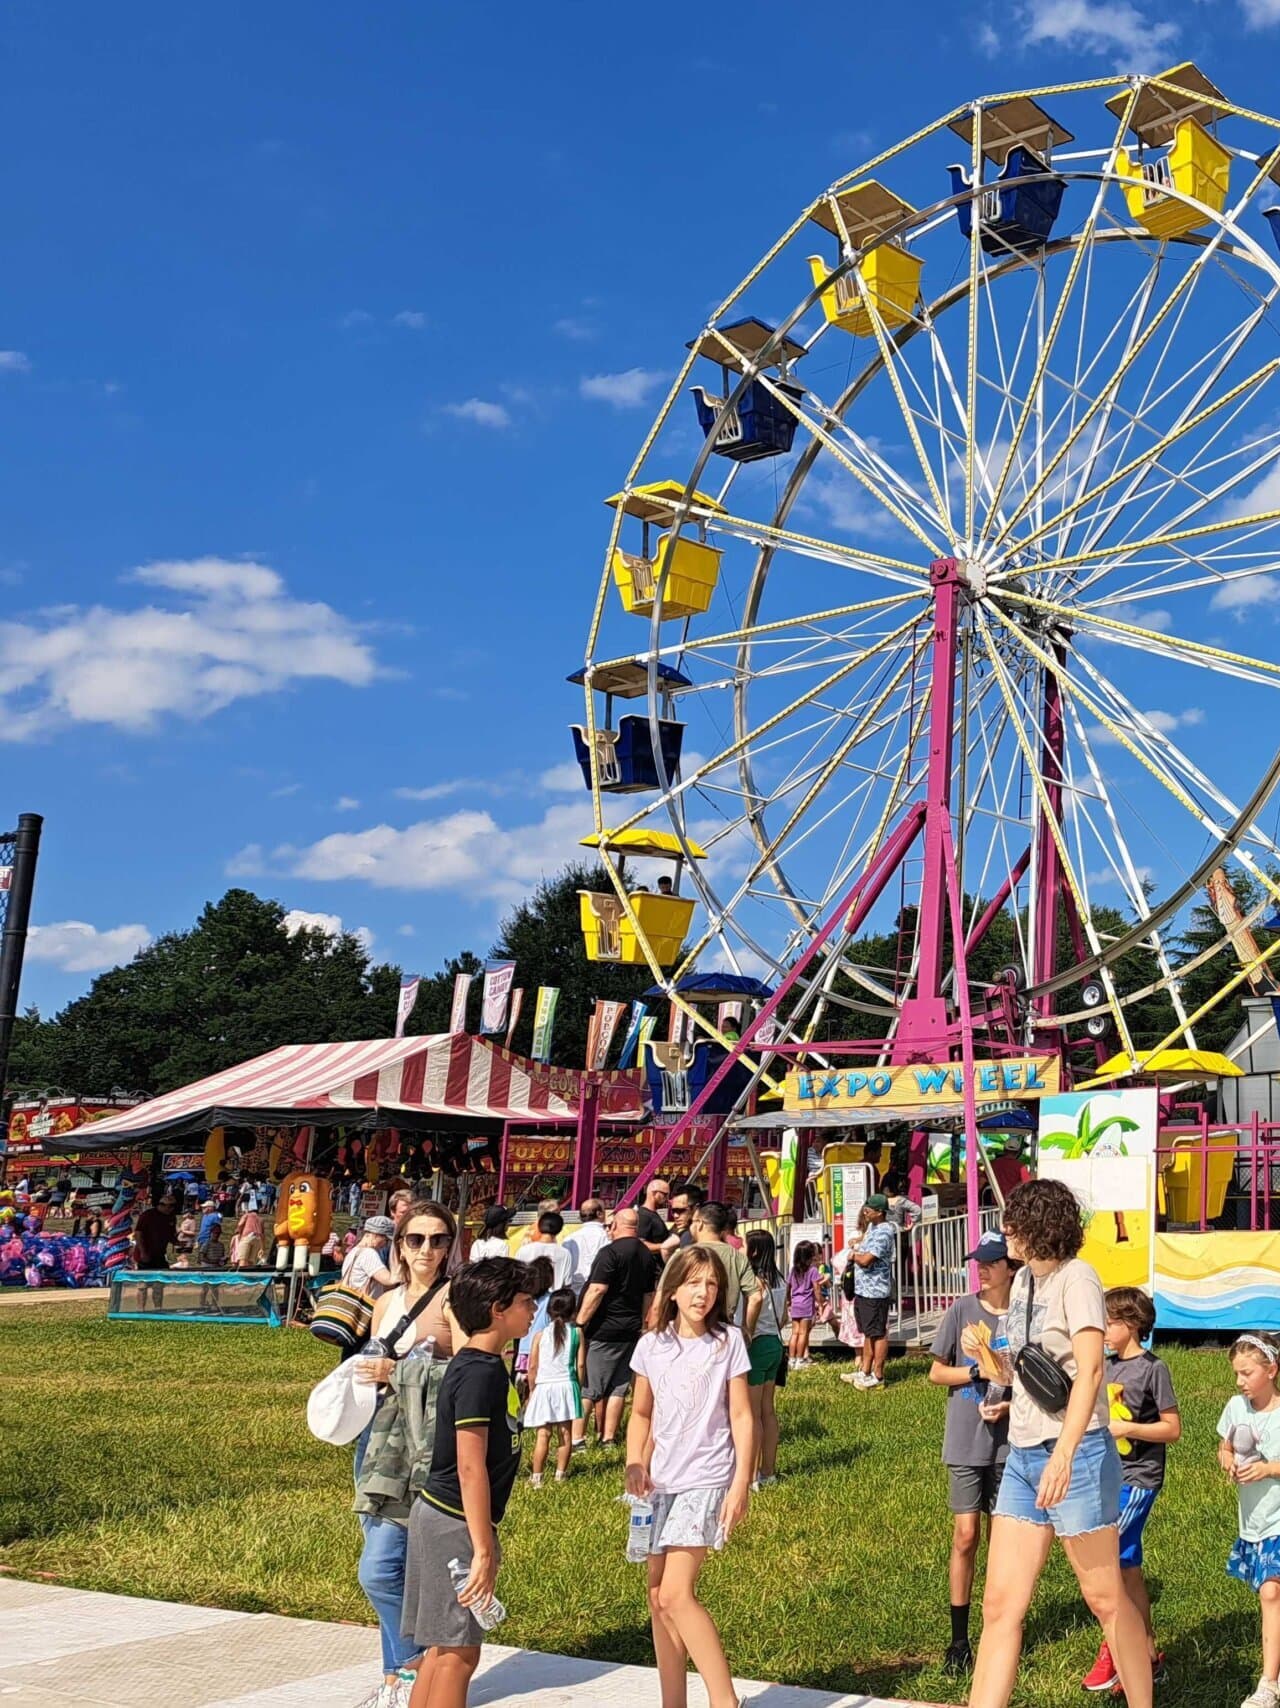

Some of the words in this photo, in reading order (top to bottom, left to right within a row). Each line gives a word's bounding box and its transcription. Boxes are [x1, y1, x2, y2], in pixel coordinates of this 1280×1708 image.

[797, 1071, 891, 1099] EXPO
[913, 1063, 1046, 1094] WHEEL
[507, 1143, 569, 1160] POPCO
[834, 1183, 842, 1208] YES
